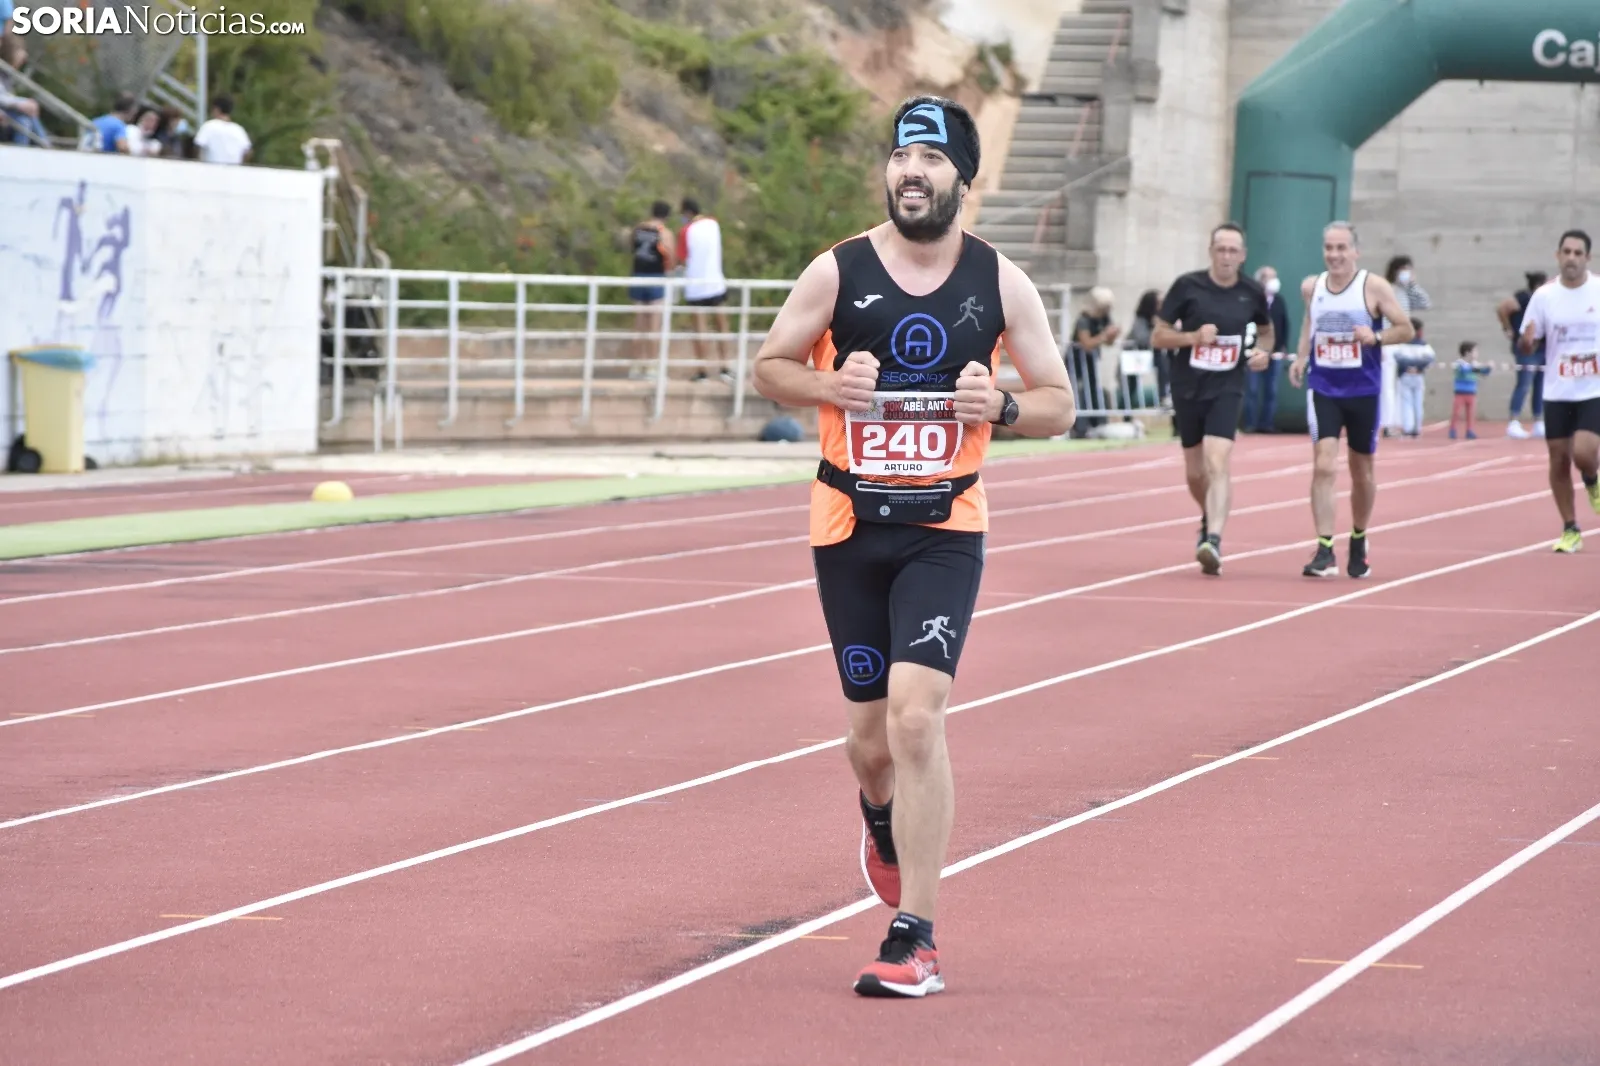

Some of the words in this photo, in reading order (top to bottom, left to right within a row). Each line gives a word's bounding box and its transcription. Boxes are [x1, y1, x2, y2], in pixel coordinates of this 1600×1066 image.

[1199, 346, 1233, 364] 381
[904, 401, 925, 411] ABEL
[884, 412, 915, 420] CIUDAD
[862, 424, 947, 459] 240
[884, 463, 923, 471] ARTURO
